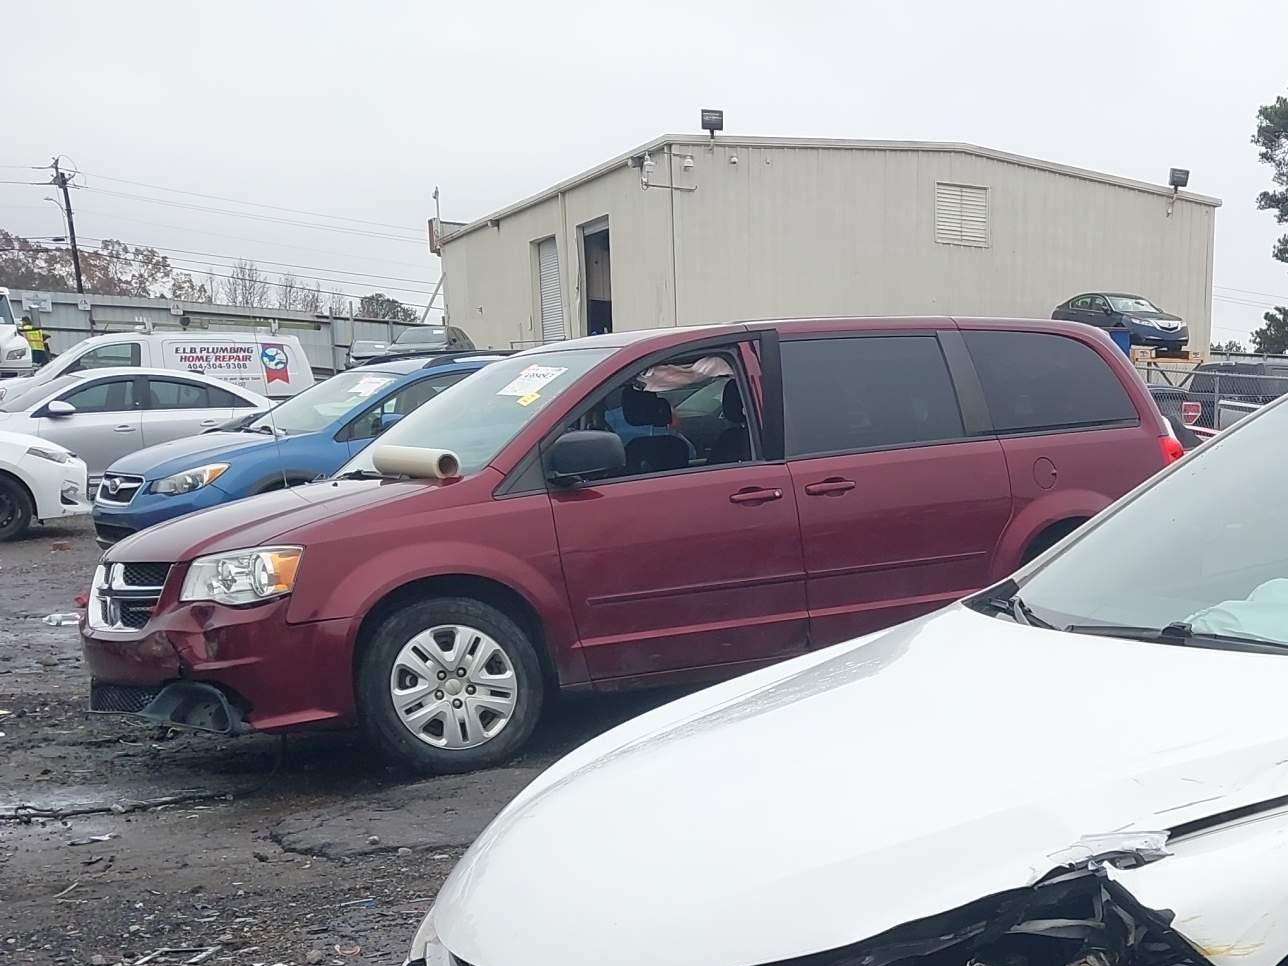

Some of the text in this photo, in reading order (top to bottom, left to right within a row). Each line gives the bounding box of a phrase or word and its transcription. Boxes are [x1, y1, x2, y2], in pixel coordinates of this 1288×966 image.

[199, 346, 254, 354] PLUMBING
[179, 354, 252, 363] HOME REPAIR
